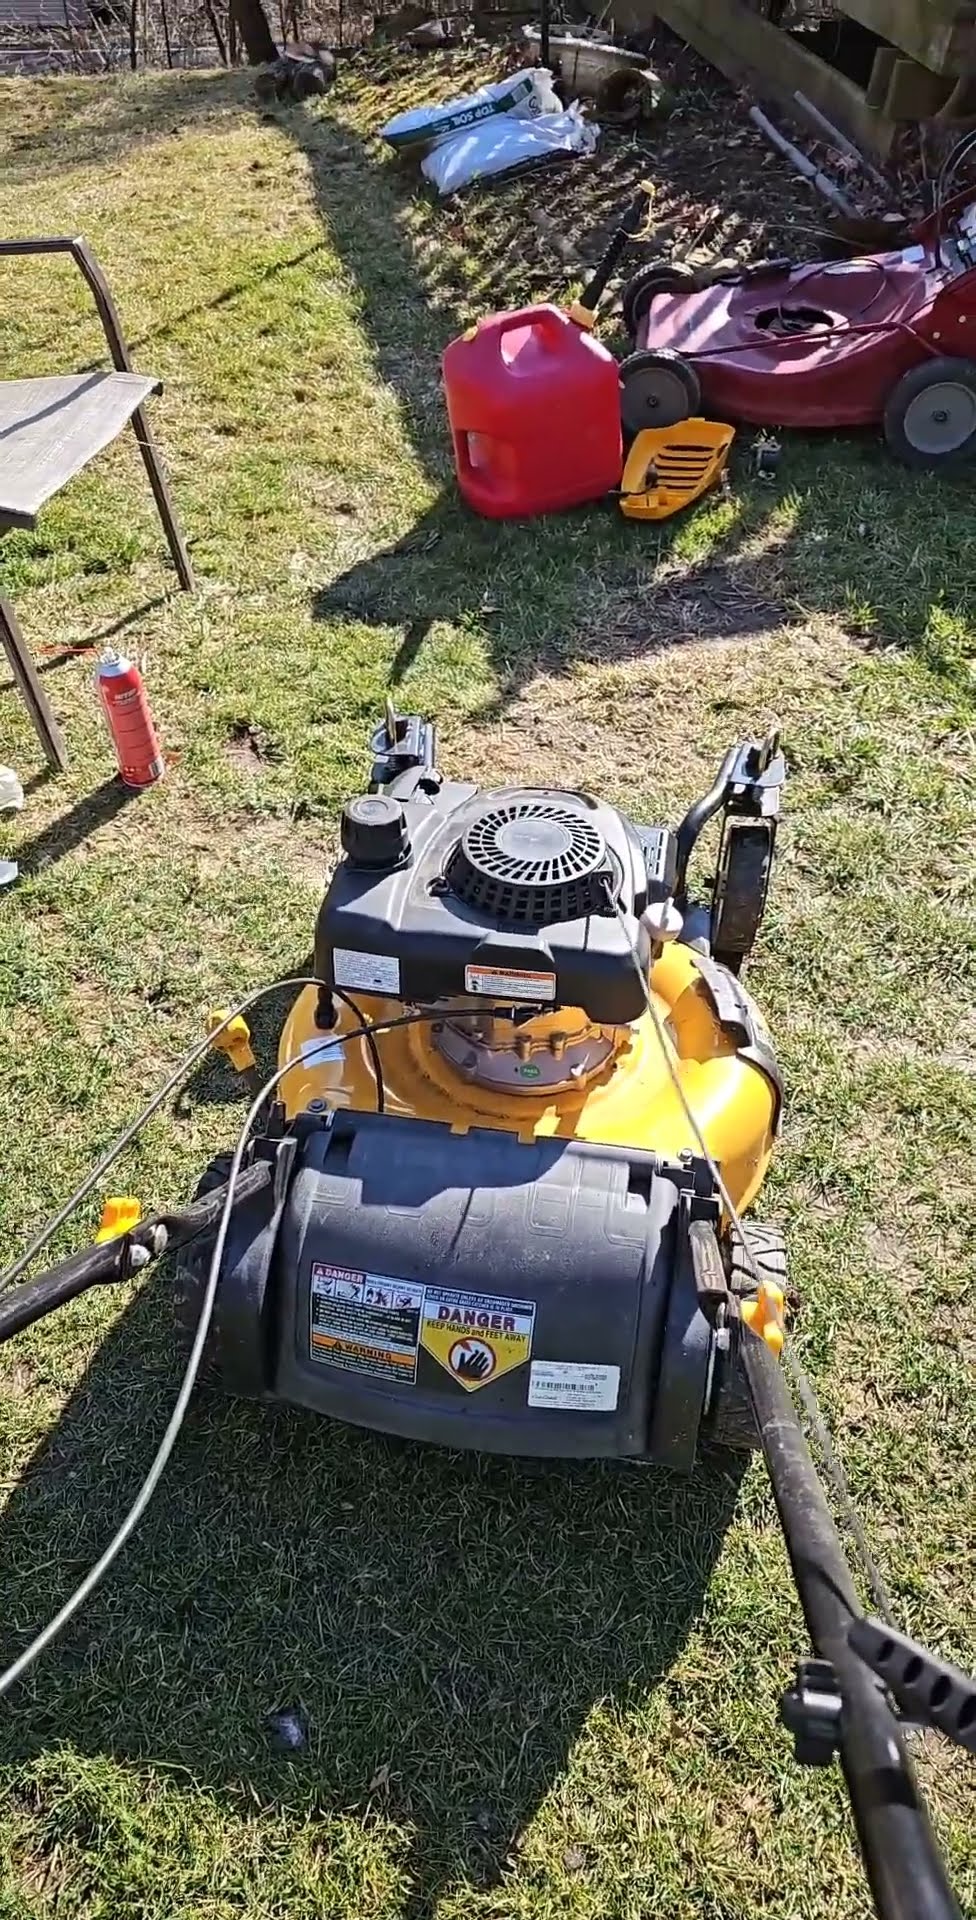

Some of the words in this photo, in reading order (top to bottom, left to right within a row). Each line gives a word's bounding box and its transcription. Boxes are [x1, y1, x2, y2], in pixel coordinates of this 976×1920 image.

[451, 111, 474, 126] SOIL
[475, 104, 495, 118] TOP
[325, 1268, 364, 1284] DANGER
[438, 1306, 515, 1331] DANGER
[427, 1320, 445, 1331] KEEP
[446, 1323, 471, 1335] HANDS
[471, 1328, 485, 1337] and
[485, 1330, 503, 1340] FEET
[504, 1333, 526, 1342] AWAY
[345, 1343, 392, 1359] WARNING
